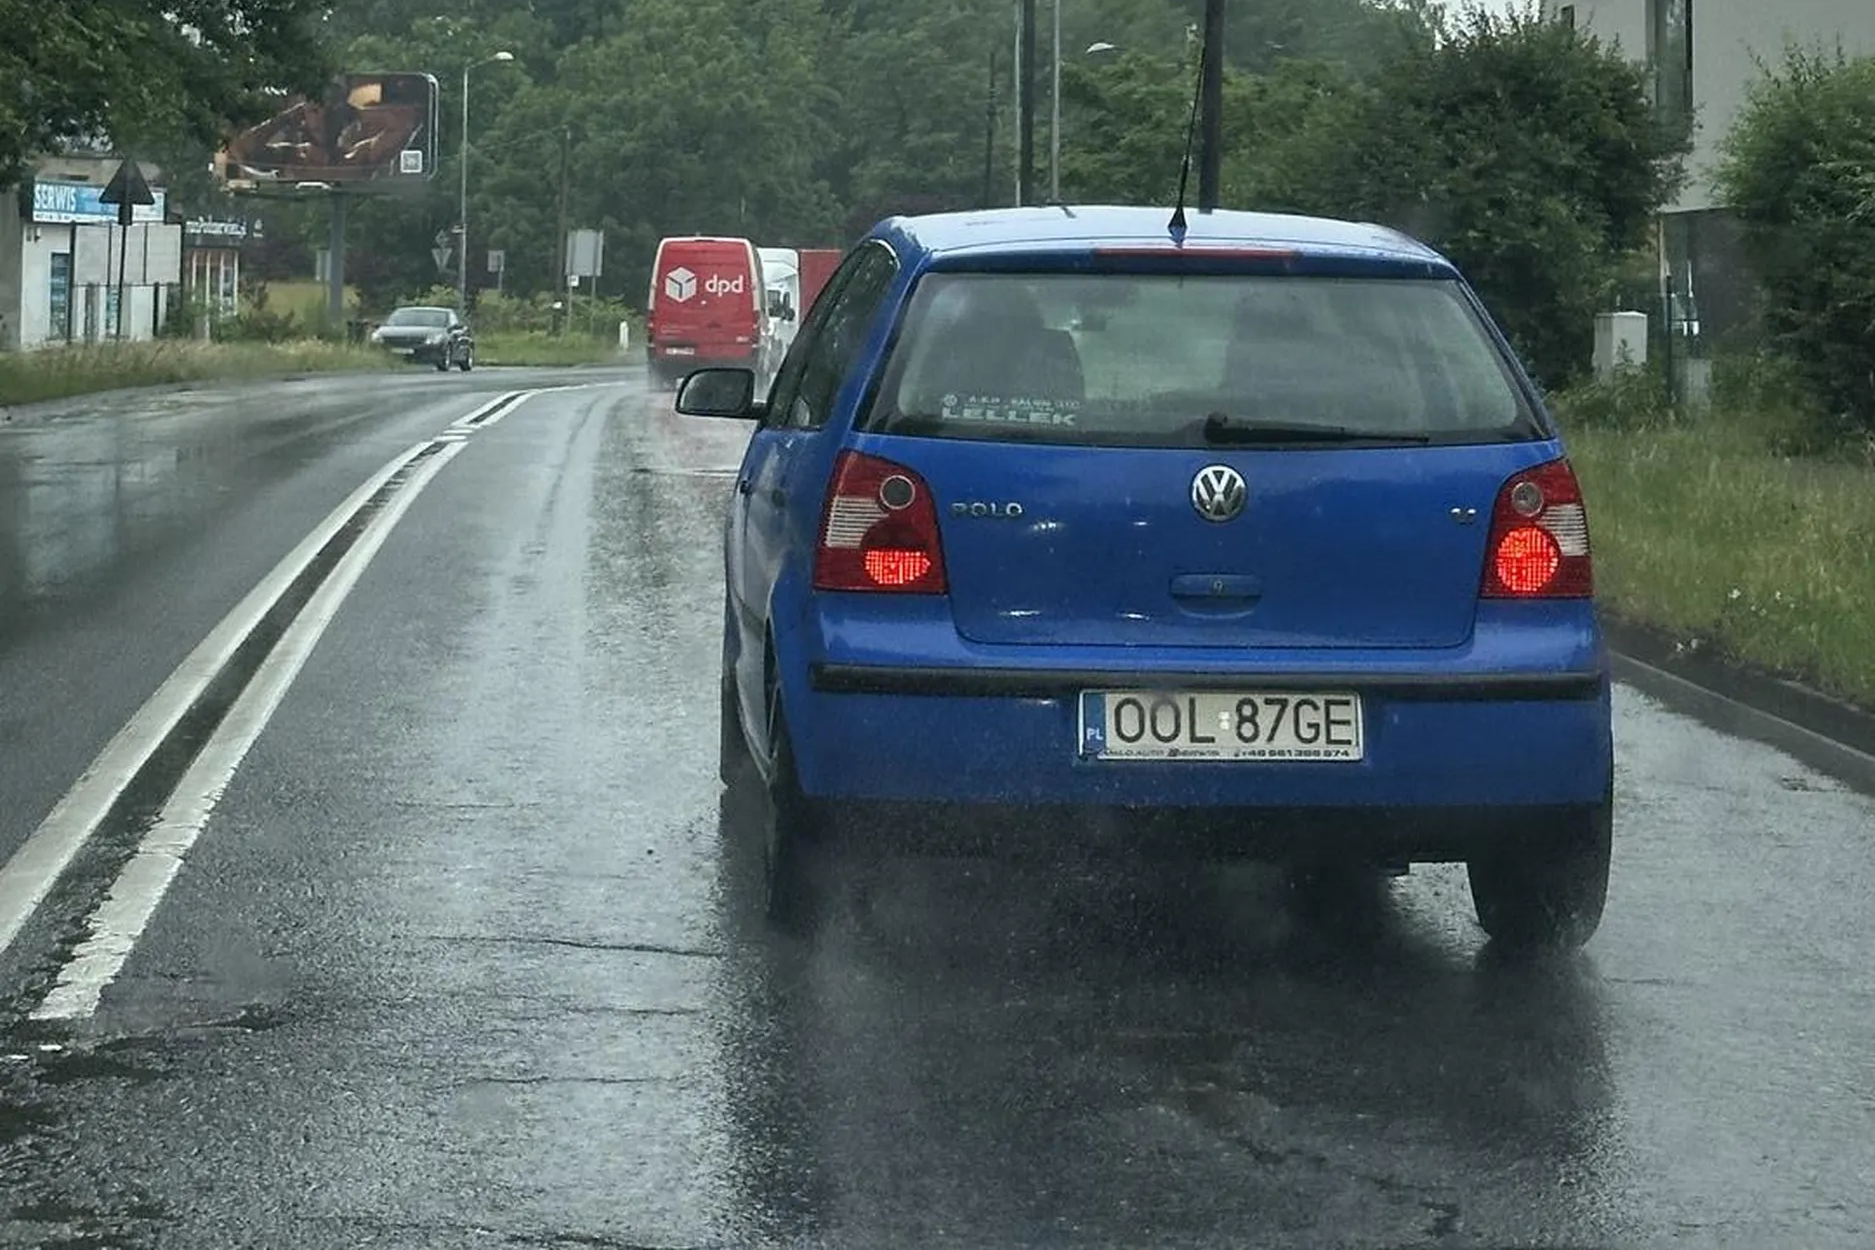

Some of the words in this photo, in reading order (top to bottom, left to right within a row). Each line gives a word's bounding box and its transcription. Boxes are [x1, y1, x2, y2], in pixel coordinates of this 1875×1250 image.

[33, 184, 77, 212] SERWIS
[705, 274, 744, 297] dpd
[951, 502, 1023, 517] POLO
[1113, 696, 1216, 744] OOL
[1235, 697, 1352, 746] 87GE
[1086, 729, 1102, 741] PL
